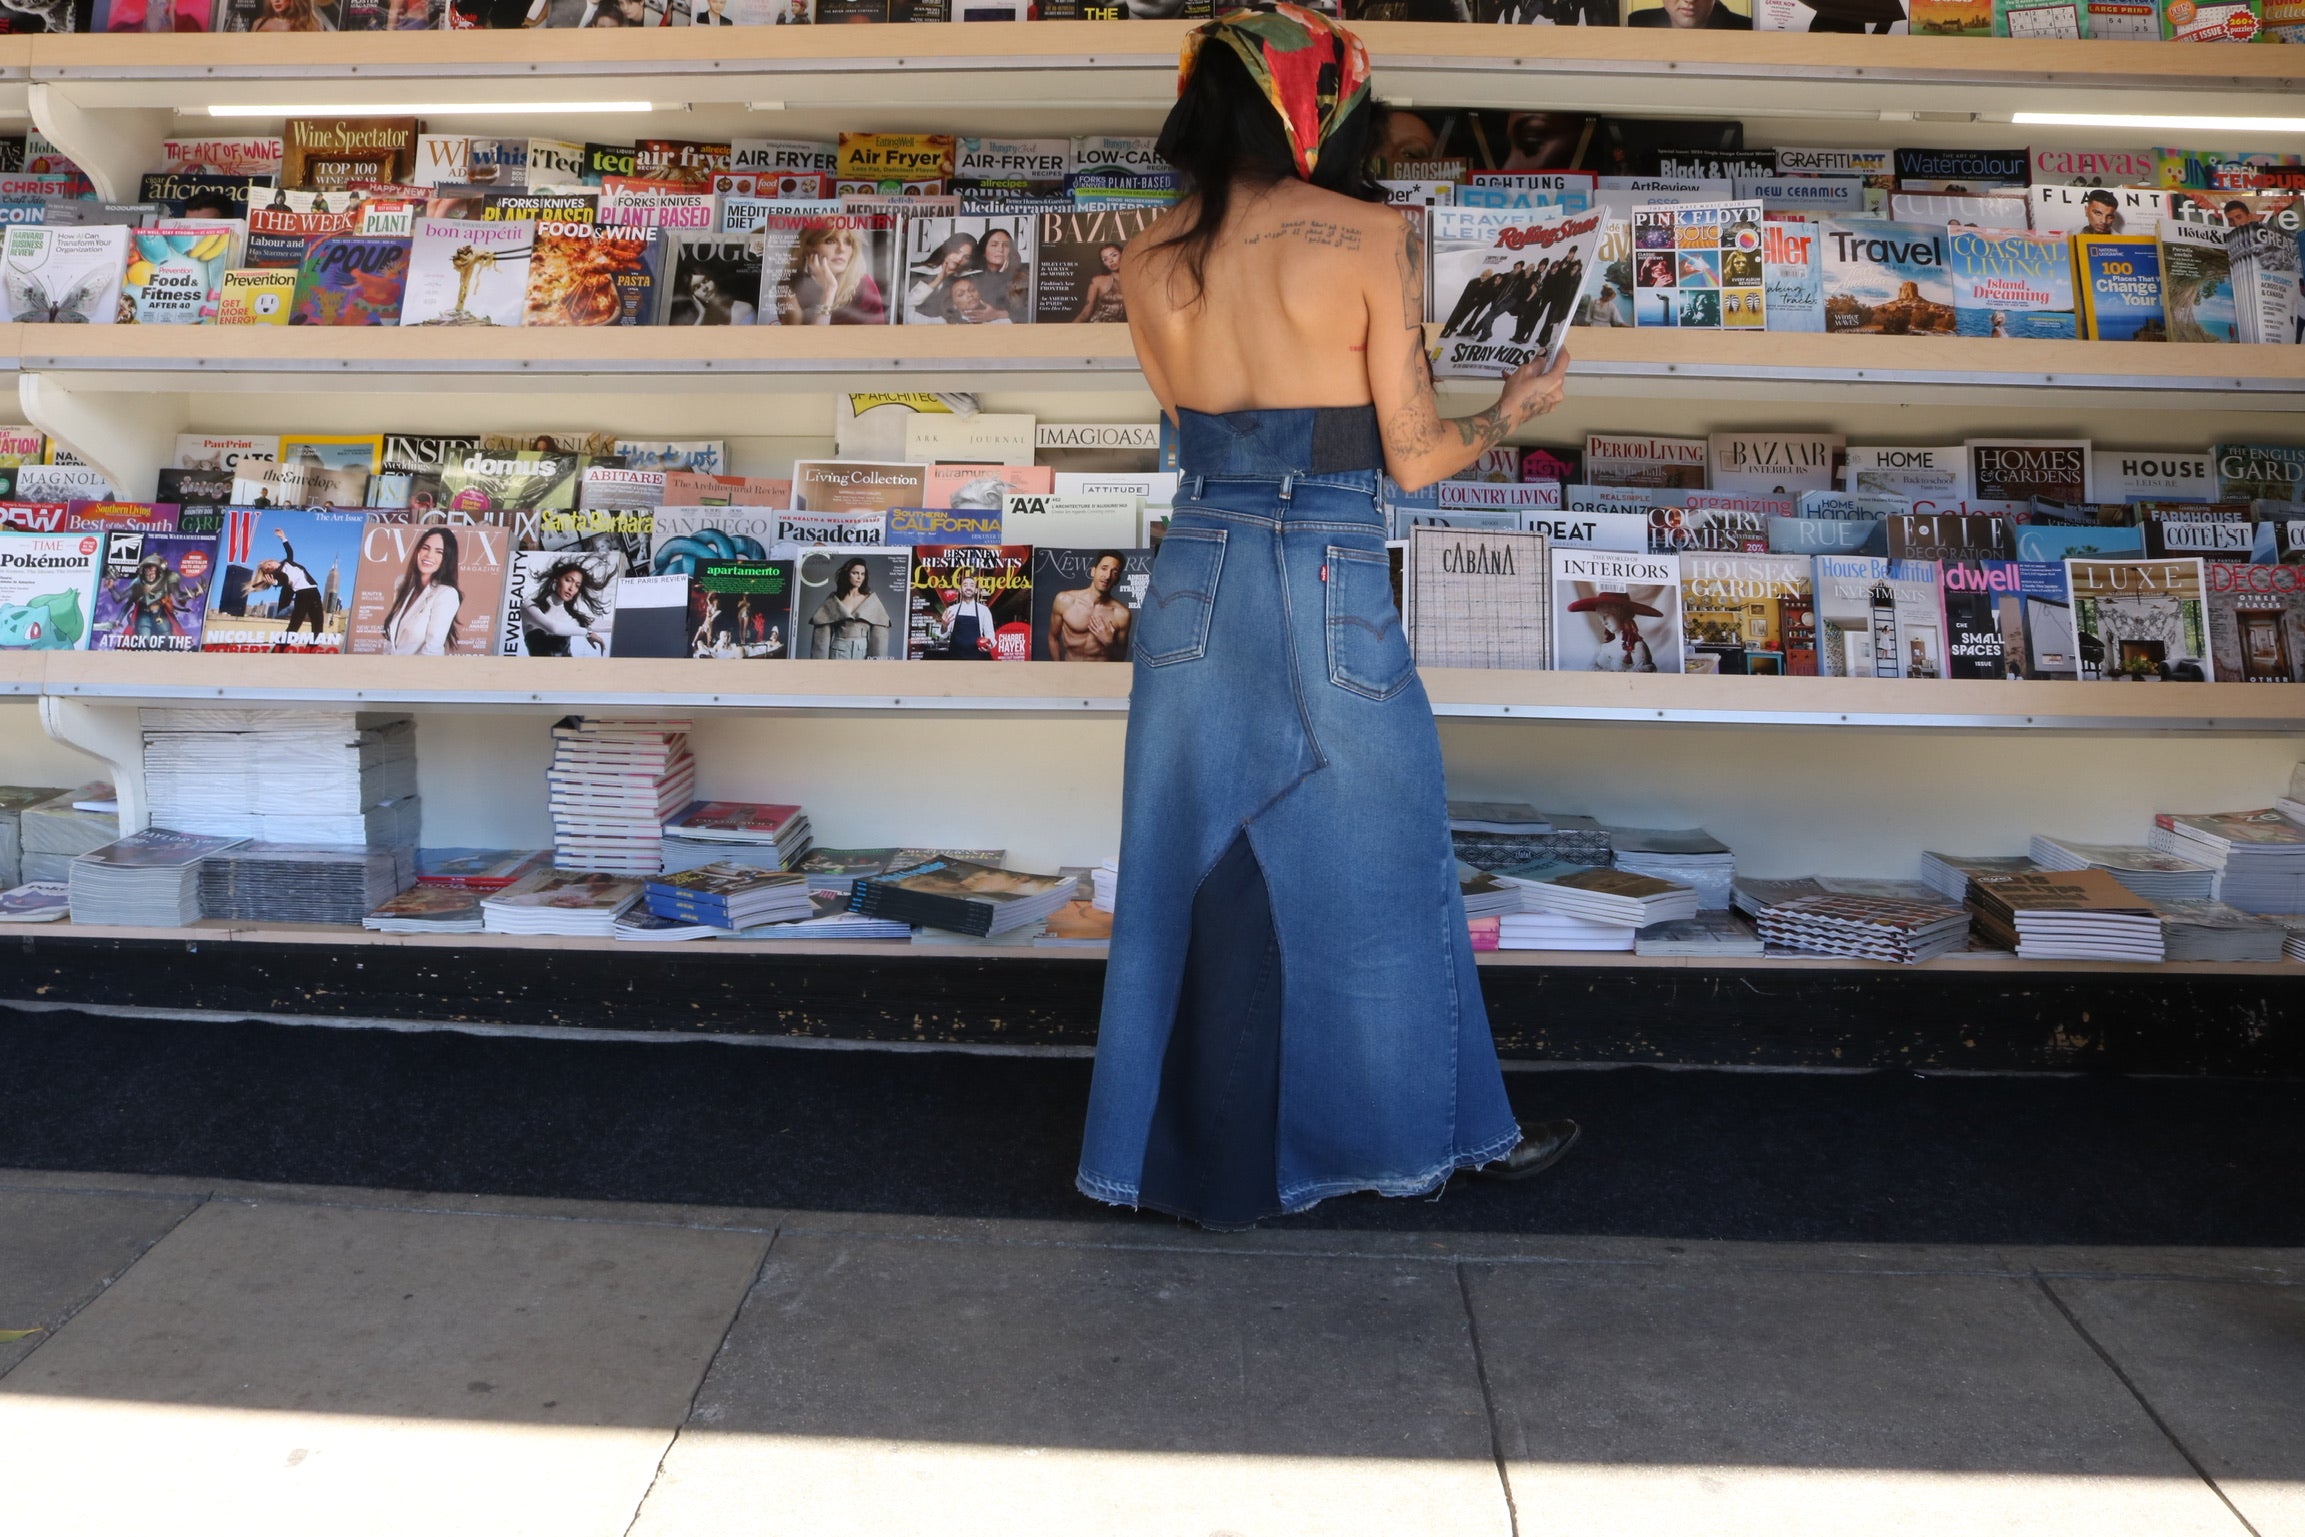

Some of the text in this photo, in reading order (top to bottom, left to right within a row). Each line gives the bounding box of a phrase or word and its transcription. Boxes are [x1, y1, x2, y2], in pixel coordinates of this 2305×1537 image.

[1084, 7, 1118, 20] THE
[2088, 6, 2117, 14] LARGE
[2228, 25, 2253, 34] puzzles
[293, 121, 409, 154] Wine Spectator
[875, 136, 915, 149] EatingWell
[165, 140, 283, 160] THE ART OF WINE
[637, 144, 675, 166] air
[735, 150, 838, 169] AIR FRYER
[850, 149, 941, 169] Air Fryer
[962, 153, 1064, 170] AIR-FRYER
[1780, 151, 1885, 169] GRAFFITI ART
[1900, 153, 2025, 175] Watercolour
[2037, 150, 2153, 176] canvas
[318, 162, 378, 175] TOP 100
[1393, 161, 1460, 180] GAGOSIAN
[1660, 158, 1774, 178] Black & White
[369, 184, 427, 196] HAPPY NEW
[980, 179, 1028, 188] allrecipes
[1631, 181, 1700, 191] ArtReview
[1755, 187, 1848, 198] NEW CERAMICS
[2043, 188, 2160, 208] FLANT
[502, 198, 585, 208] FORKS KNIVES
[618, 197, 701, 207] FORKS KNIVES
[253, 210, 355, 232] THE WEEK
[366, 215, 409, 233] PLANT
[600, 206, 711, 228] PLANT BASED
[726, 217, 755, 229] DIET
[1635, 208, 1761, 227] PINK FLOYD
[13, 232, 44, 240] HARVARD
[425, 223, 523, 245] bon appétit
[537, 222, 658, 241] FOOD & WINE
[1495, 215, 1599, 250] Rolling Stone
[1674, 225, 1724, 241] SOLO
[11, 240, 44, 249] BUSINESS
[250, 236, 304, 248] Labour and
[1829, 231, 1942, 266] Travel
[1954, 236, 2067, 262] COASTAL
[10, 248, 35, 257] REVIEW
[159, 267, 193, 275] Prevention
[1966, 255, 2055, 279] LIVING
[2102, 262, 2133, 275] 100
[149, 274, 199, 287] Food &
[224, 271, 296, 287] Prevention
[617, 275, 651, 287] PASTA
[1987, 278, 2025, 290] Island
[2096, 278, 2157, 295] Change
[2113, 275, 2136, 283] Places
[141, 287, 202, 301] Fitness
[1973, 285, 2050, 305] Dreaming
[2120, 293, 2157, 306] Your
[149, 302, 190, 310] AFTER 40
[221, 308, 249, 316] MORE
[222, 300, 241, 308] GET
[219, 316, 257, 325] ENERGY
[1451, 343, 1536, 365] STRAY KIDS
[1590, 437, 1704, 461] PERIOD LIVING
[1733, 441, 1826, 467] BAZAAR
[2229, 447, 2247, 456] THE
[463, 453, 557, 477] domus
[1877, 451, 1934, 468] HOME
[1980, 450, 2081, 471] HOMES
[2122, 459, 2205, 478] HOUSE
[589, 470, 663, 485] ABITARE
[806, 470, 918, 487] Living Collection
[1995, 470, 2081, 484] GARDENS
[2135, 479, 2178, 488] LEISURE
[1088, 486, 1143, 494] ATTITUDE
[1441, 486, 1558, 505] COUNTRY LIVING
[96, 503, 152, 519] Southern Living
[1686, 496, 1793, 518] organizing
[1822, 500, 1854, 509] HOME
[315, 513, 363, 523] The Art Issue
[541, 509, 654, 534] Santa Barbara
[893, 508, 948, 519] SOUTHERN
[1648, 508, 1767, 532] COUNTRY
[2151, 510, 2242, 523] FARMHOUSE
[69, 516, 105, 531] Best
[125, 516, 173, 532] South
[656, 518, 767, 535] SAN DIEGO
[891, 517, 1002, 532] CALIFORNIA
[778, 522, 881, 544] Pasadena
[1651, 528, 1739, 550] HOMES
[1801, 521, 1855, 547] RUE
[32, 540, 64, 551] TIME
[1747, 543, 1764, 553] 20%
[1905, 546, 2005, 560] DECORATION
[1, 553, 89, 568] Pokémon
[943, 549, 1002, 559] BEST NEW
[1443, 542, 1516, 576] CABANA
[923, 557, 1023, 569] RESTAURANTS
[1564, 559, 1670, 579] INTERIORS
[1822, 557, 1934, 584] House Beautiful
[707, 566, 780, 577] apartamento
[1692, 560, 1801, 583] HOUSE &
[1946, 562, 2021, 592] dwell
[2088, 566, 2183, 590] LUXE
[1691, 578, 1801, 600] GARDEN
[2239, 594, 2277, 602] OTHER
[100, 634, 192, 650] ATTACK OF THE
[206, 631, 266, 645] NICOLE
[269, 632, 340, 646] KIDMAN
[1962, 632, 2005, 645] SMALL
[998, 642, 1025, 653] HAYEK
[1951, 644, 2001, 656] SPACES
